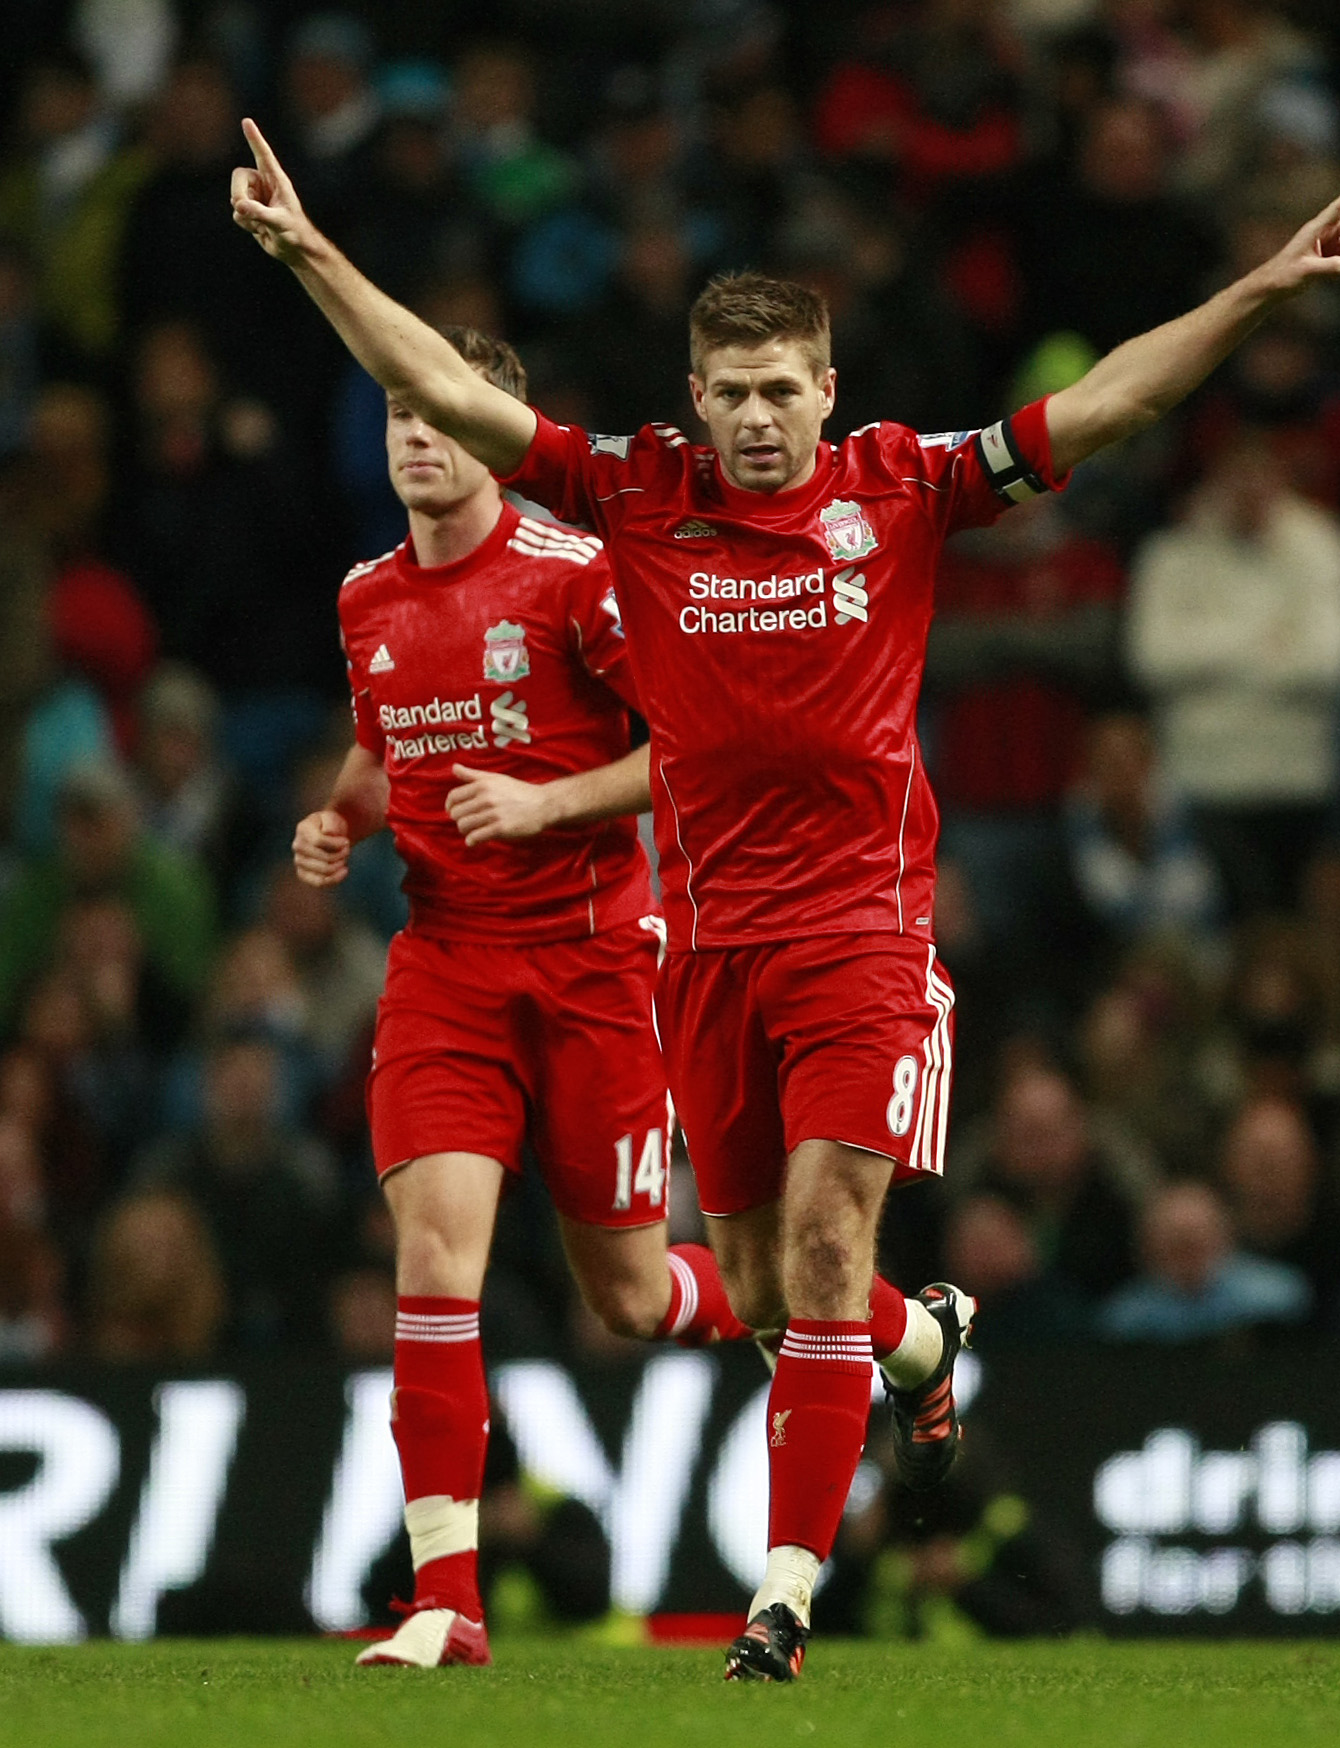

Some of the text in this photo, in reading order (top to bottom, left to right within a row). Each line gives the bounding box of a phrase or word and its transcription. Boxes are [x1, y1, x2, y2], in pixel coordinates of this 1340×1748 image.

[674, 529, 717, 539] adidas
[689, 568, 825, 599] Standard
[679, 601, 827, 634] Chartered
[379, 693, 482, 730] Standard
[887, 1055, 917, 1137] 8
[612, 1128, 665, 1210] 14
